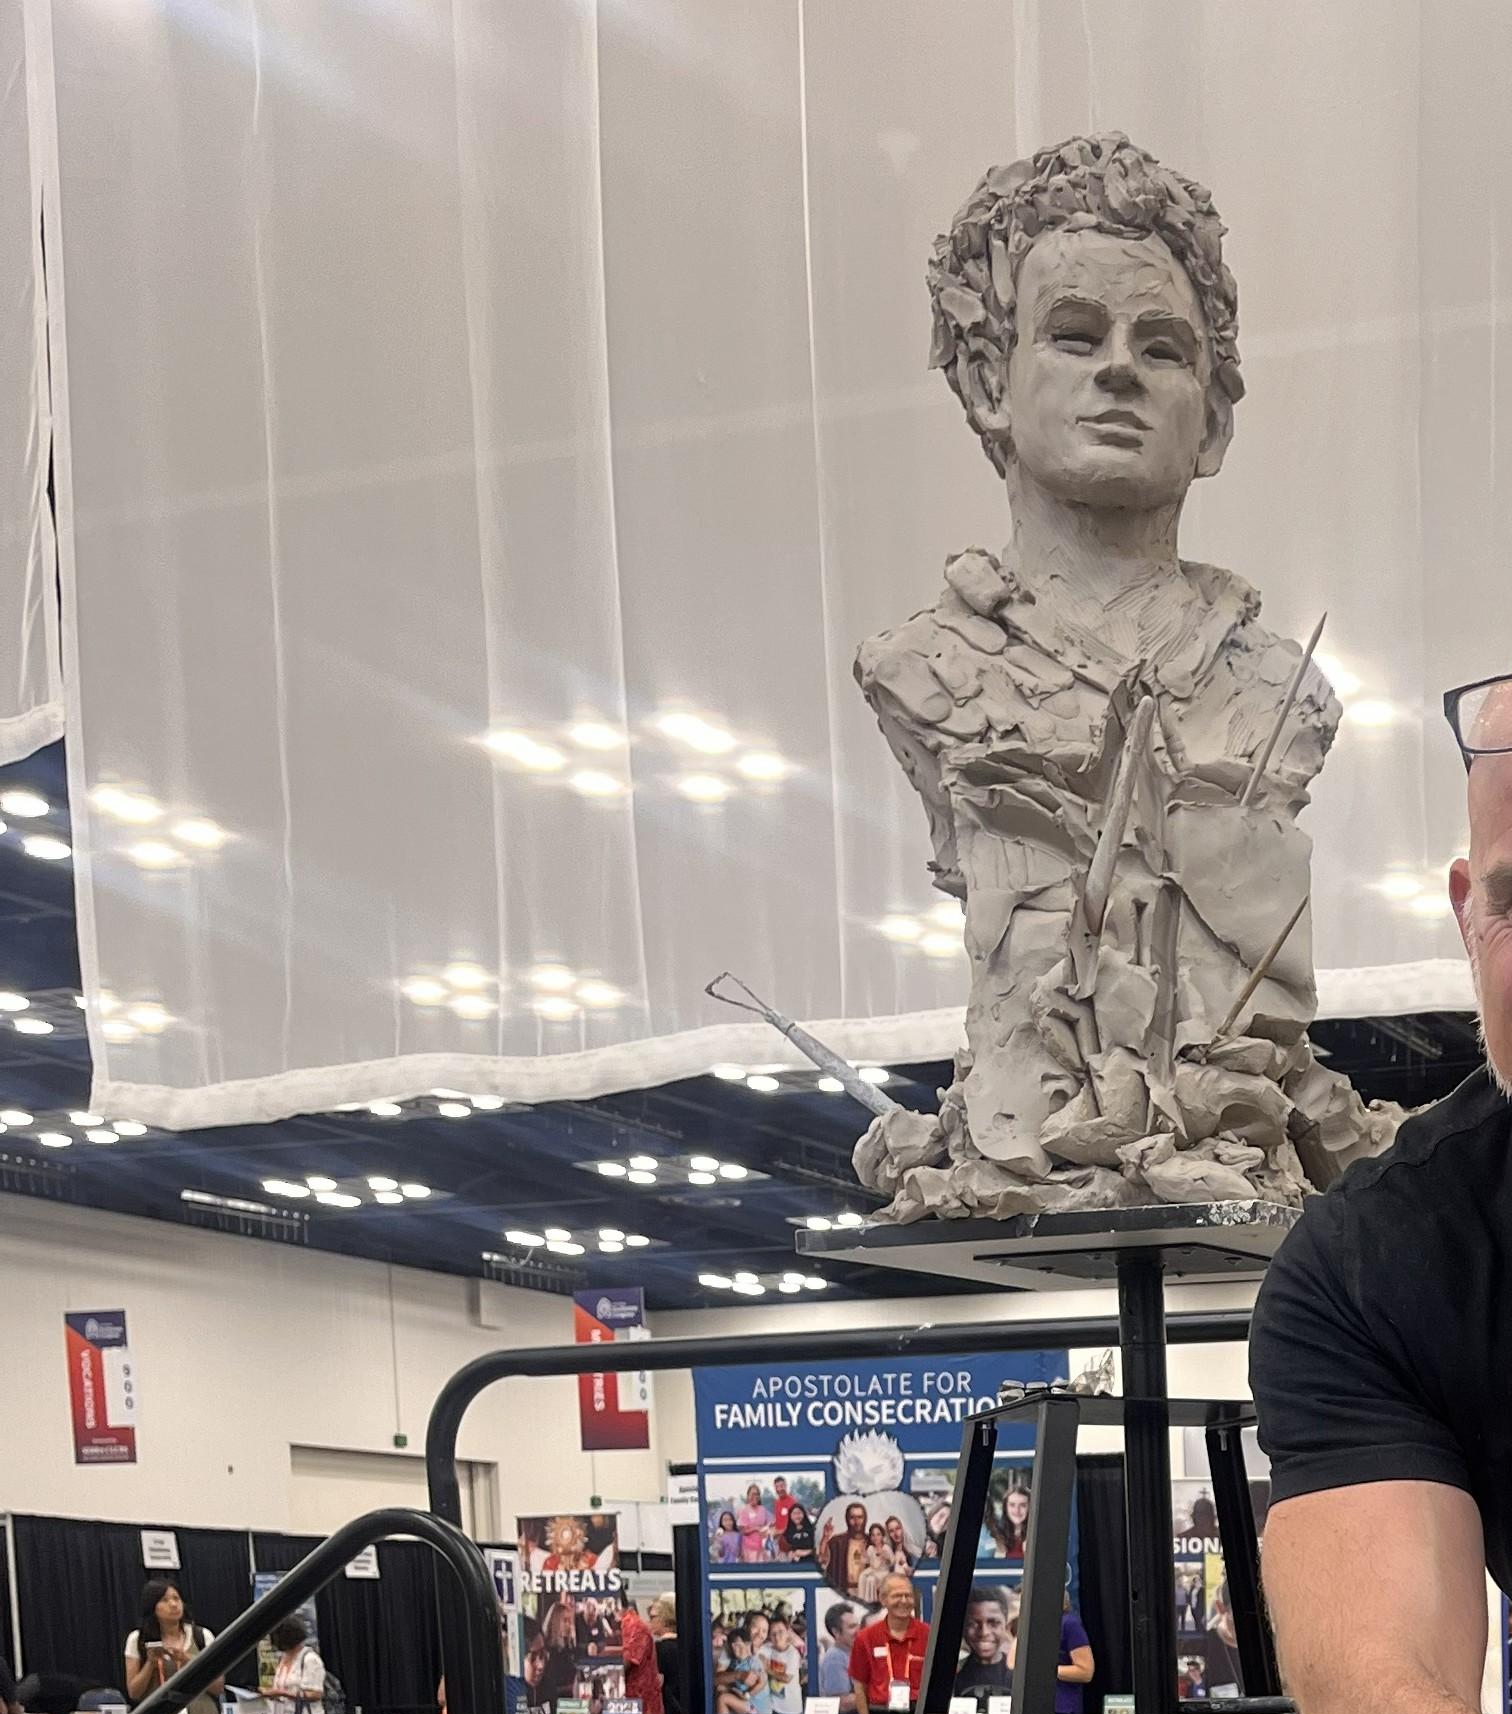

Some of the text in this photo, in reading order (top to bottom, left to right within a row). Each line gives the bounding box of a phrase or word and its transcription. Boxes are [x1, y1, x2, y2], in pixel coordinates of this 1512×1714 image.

[752, 1371, 971, 1399] APOSTOLATE FOR
[714, 1396, 1003, 1429] FAMILY CONSECRATIO
[520, 1568, 621, 1593] RETREATS
